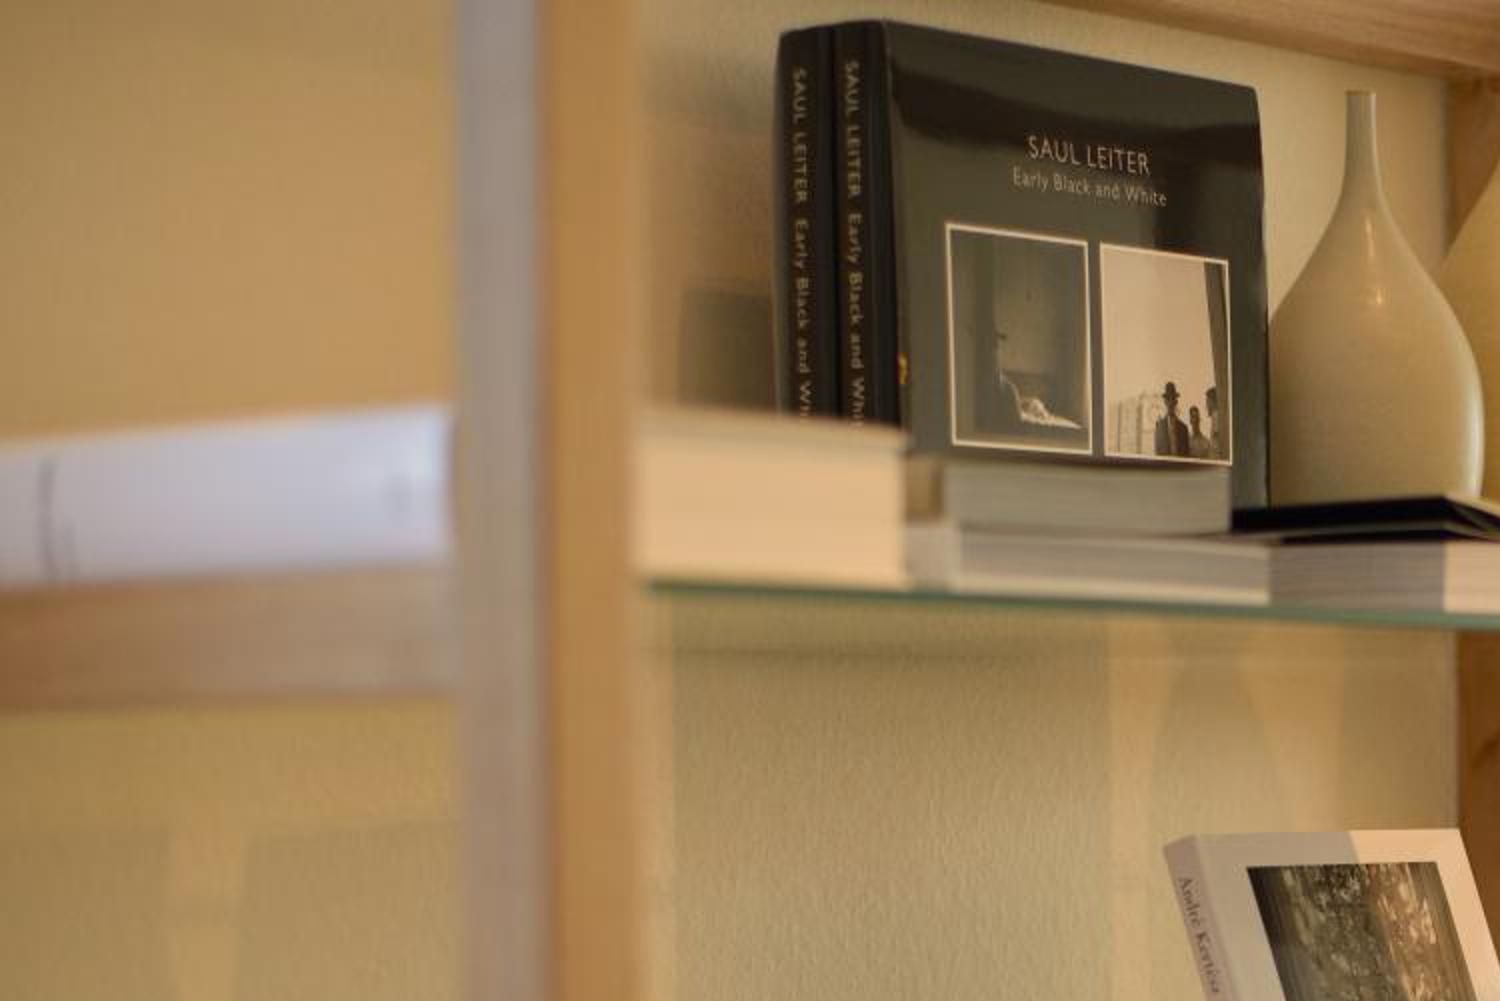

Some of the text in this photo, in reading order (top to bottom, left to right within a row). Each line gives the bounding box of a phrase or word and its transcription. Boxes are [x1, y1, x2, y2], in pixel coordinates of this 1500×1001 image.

[791, 68, 807, 124] SAUL
[845, 61, 860, 117] SAUL
[793, 131, 809, 202] LEITER
[847, 125, 862, 199] LEITER
[1028, 134, 1151, 176] SAUL LEITER
[1012, 165, 1168, 207] Early Black and White
[794, 218, 809, 269] Early
[848, 213, 863, 264] Early
[796, 277, 811, 330] Black
[849, 272, 864, 325] Black
[798, 337, 811, 373] and
[851, 334, 865, 369] and
